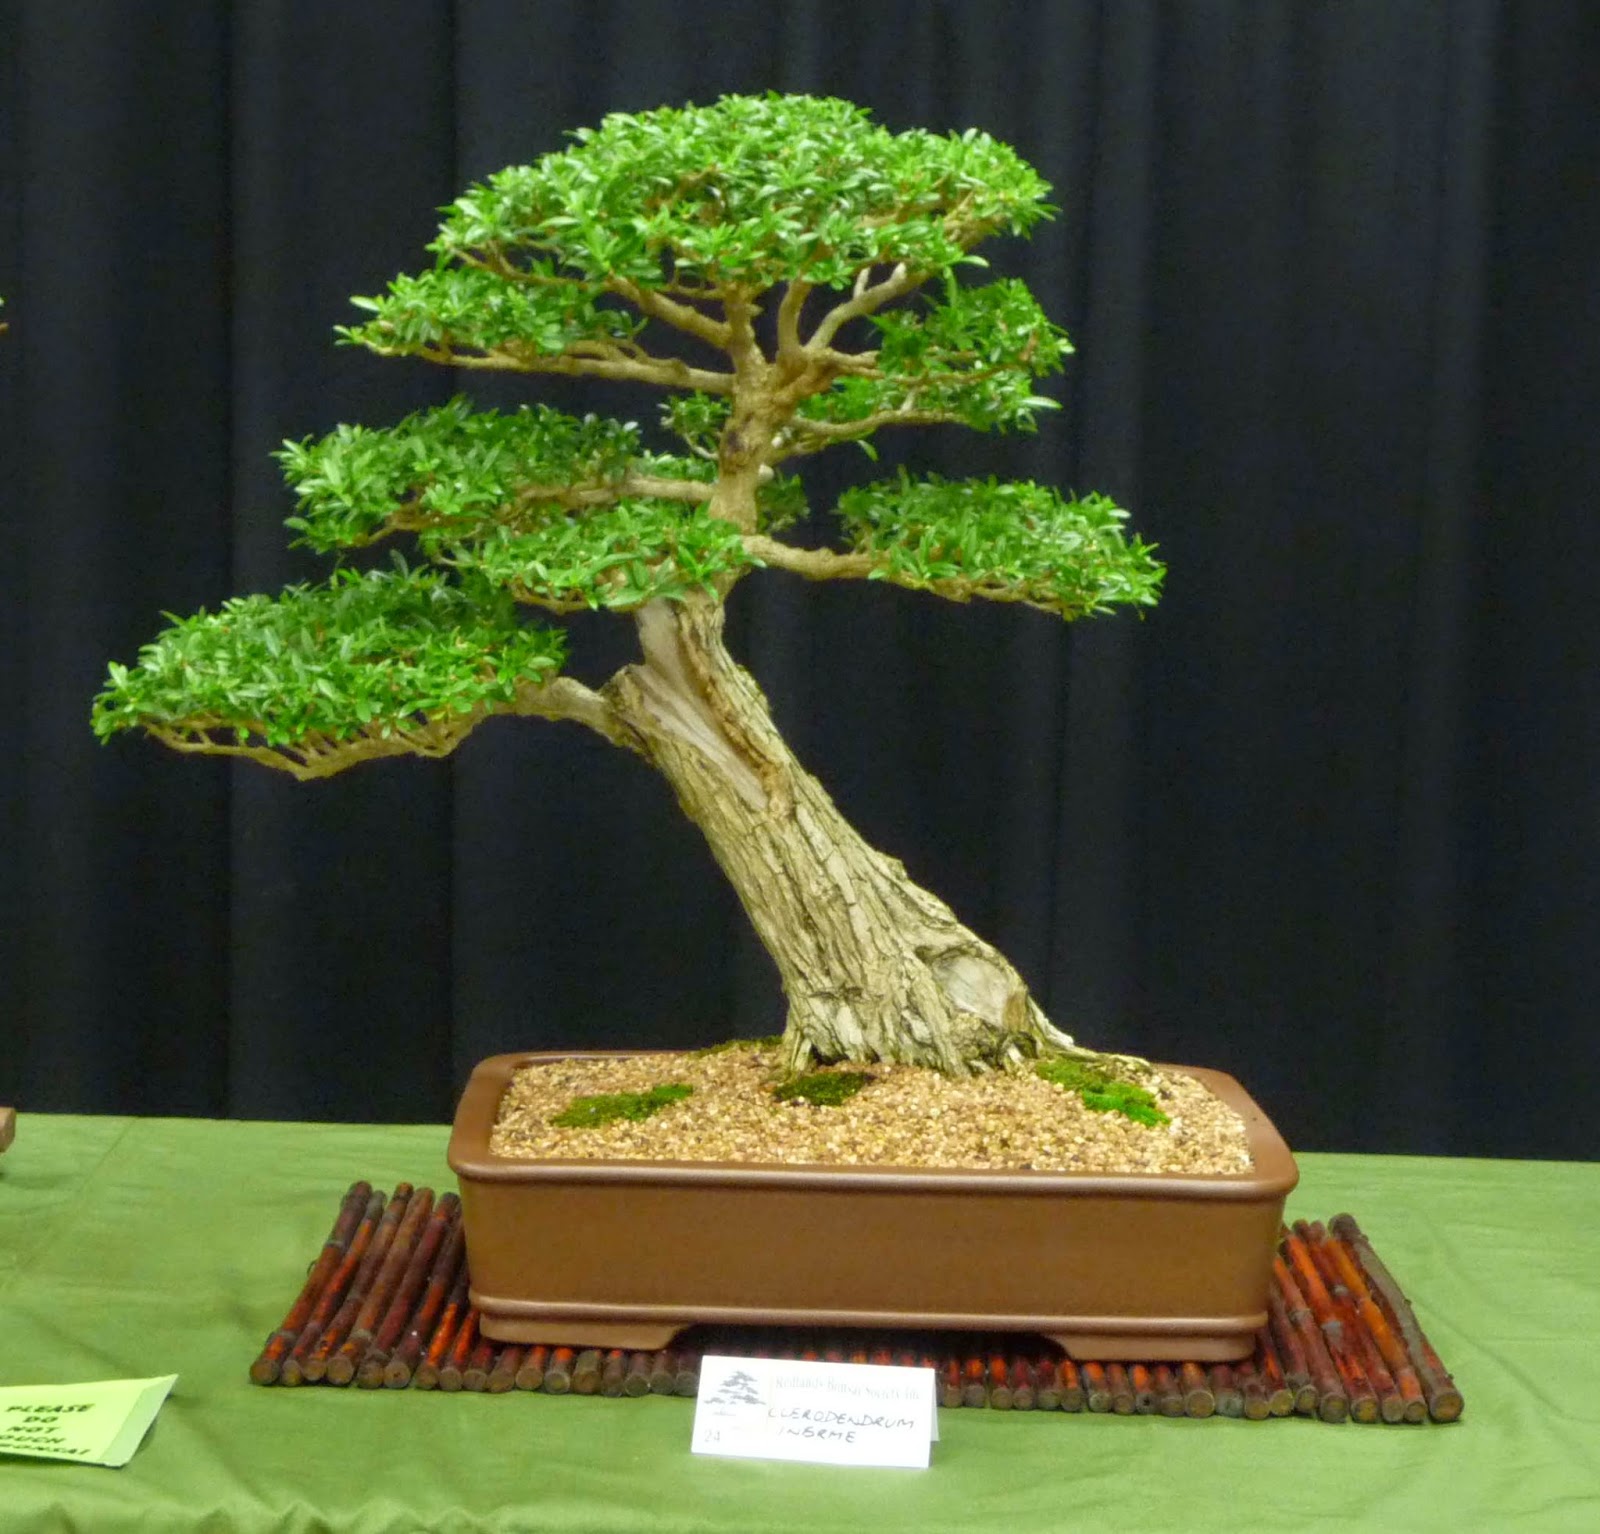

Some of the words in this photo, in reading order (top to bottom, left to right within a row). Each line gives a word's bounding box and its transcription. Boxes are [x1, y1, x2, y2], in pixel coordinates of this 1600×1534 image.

[827, 1376, 861, 1396] Bonsai
[865, 1384, 900, 1400] Society
[5, 1403, 95, 1413] PLEASE
[22, 1415, 59, 1423] DO
[768, 1407, 915, 1429] CLERODENDRUM
[6, 1426, 60, 1434] NOT
[0, 1435, 66, 1444] OUCH
